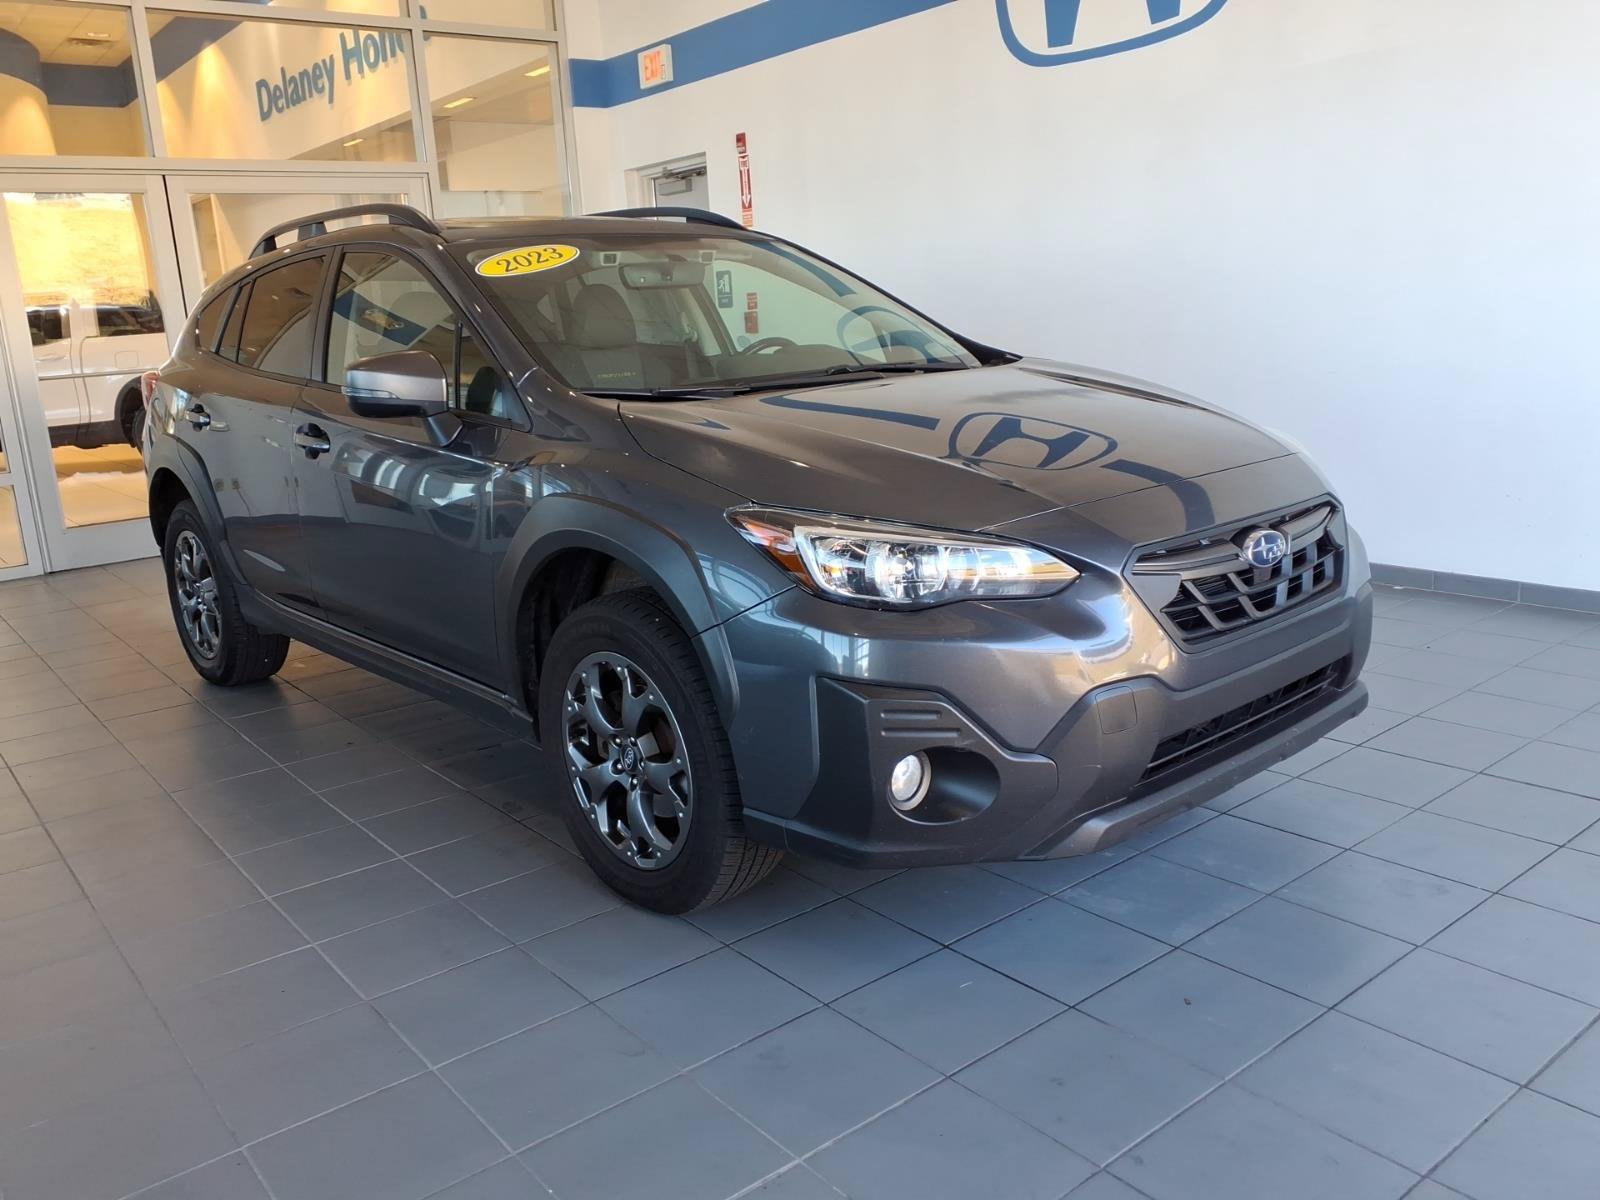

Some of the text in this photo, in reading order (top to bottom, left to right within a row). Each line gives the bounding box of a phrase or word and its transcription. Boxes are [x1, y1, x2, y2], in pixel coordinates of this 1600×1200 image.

[255, 14, 422, 122] Delaney Hon
[496, 247, 564, 273] 2023
